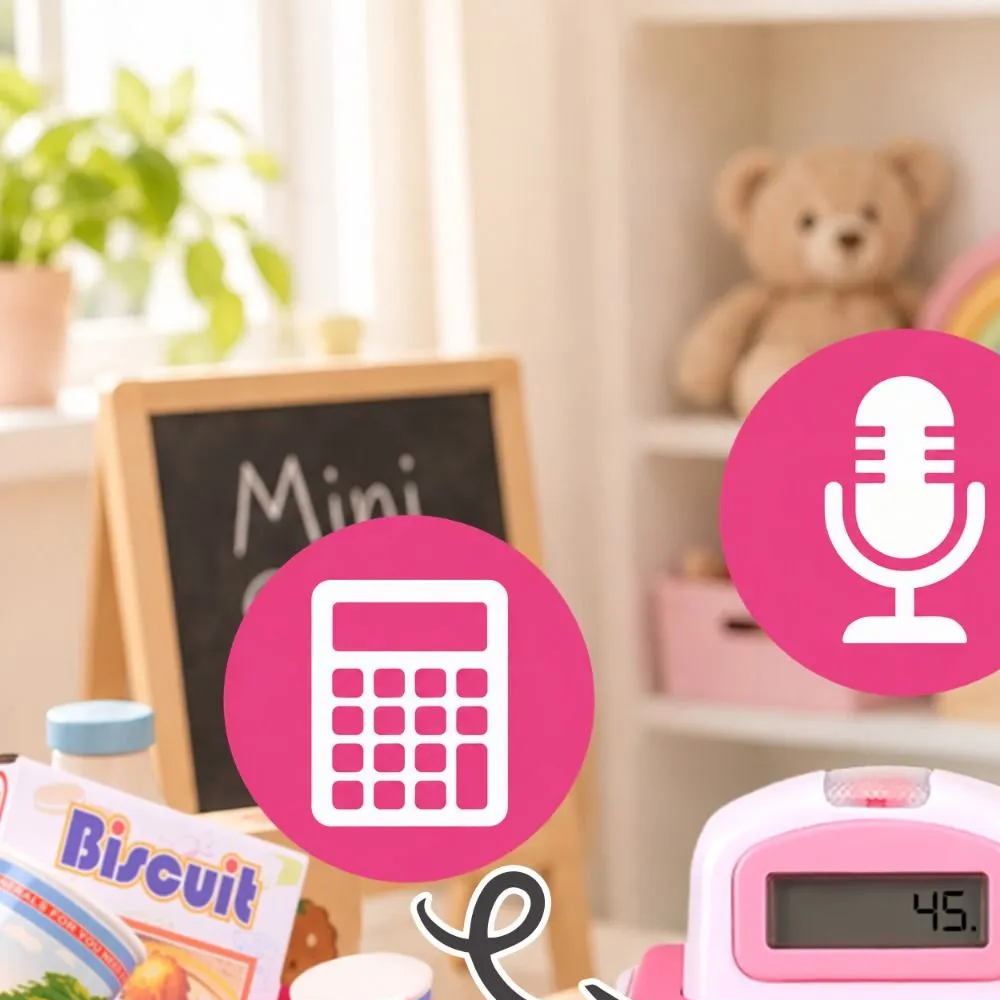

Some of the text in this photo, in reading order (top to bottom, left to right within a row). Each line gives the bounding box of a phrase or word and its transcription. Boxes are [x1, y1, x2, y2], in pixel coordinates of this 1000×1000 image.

[57, 805, 261, 930] Biscuit
[48, 907, 78, 934] FOR
[76, 930, 105, 956] YOU
